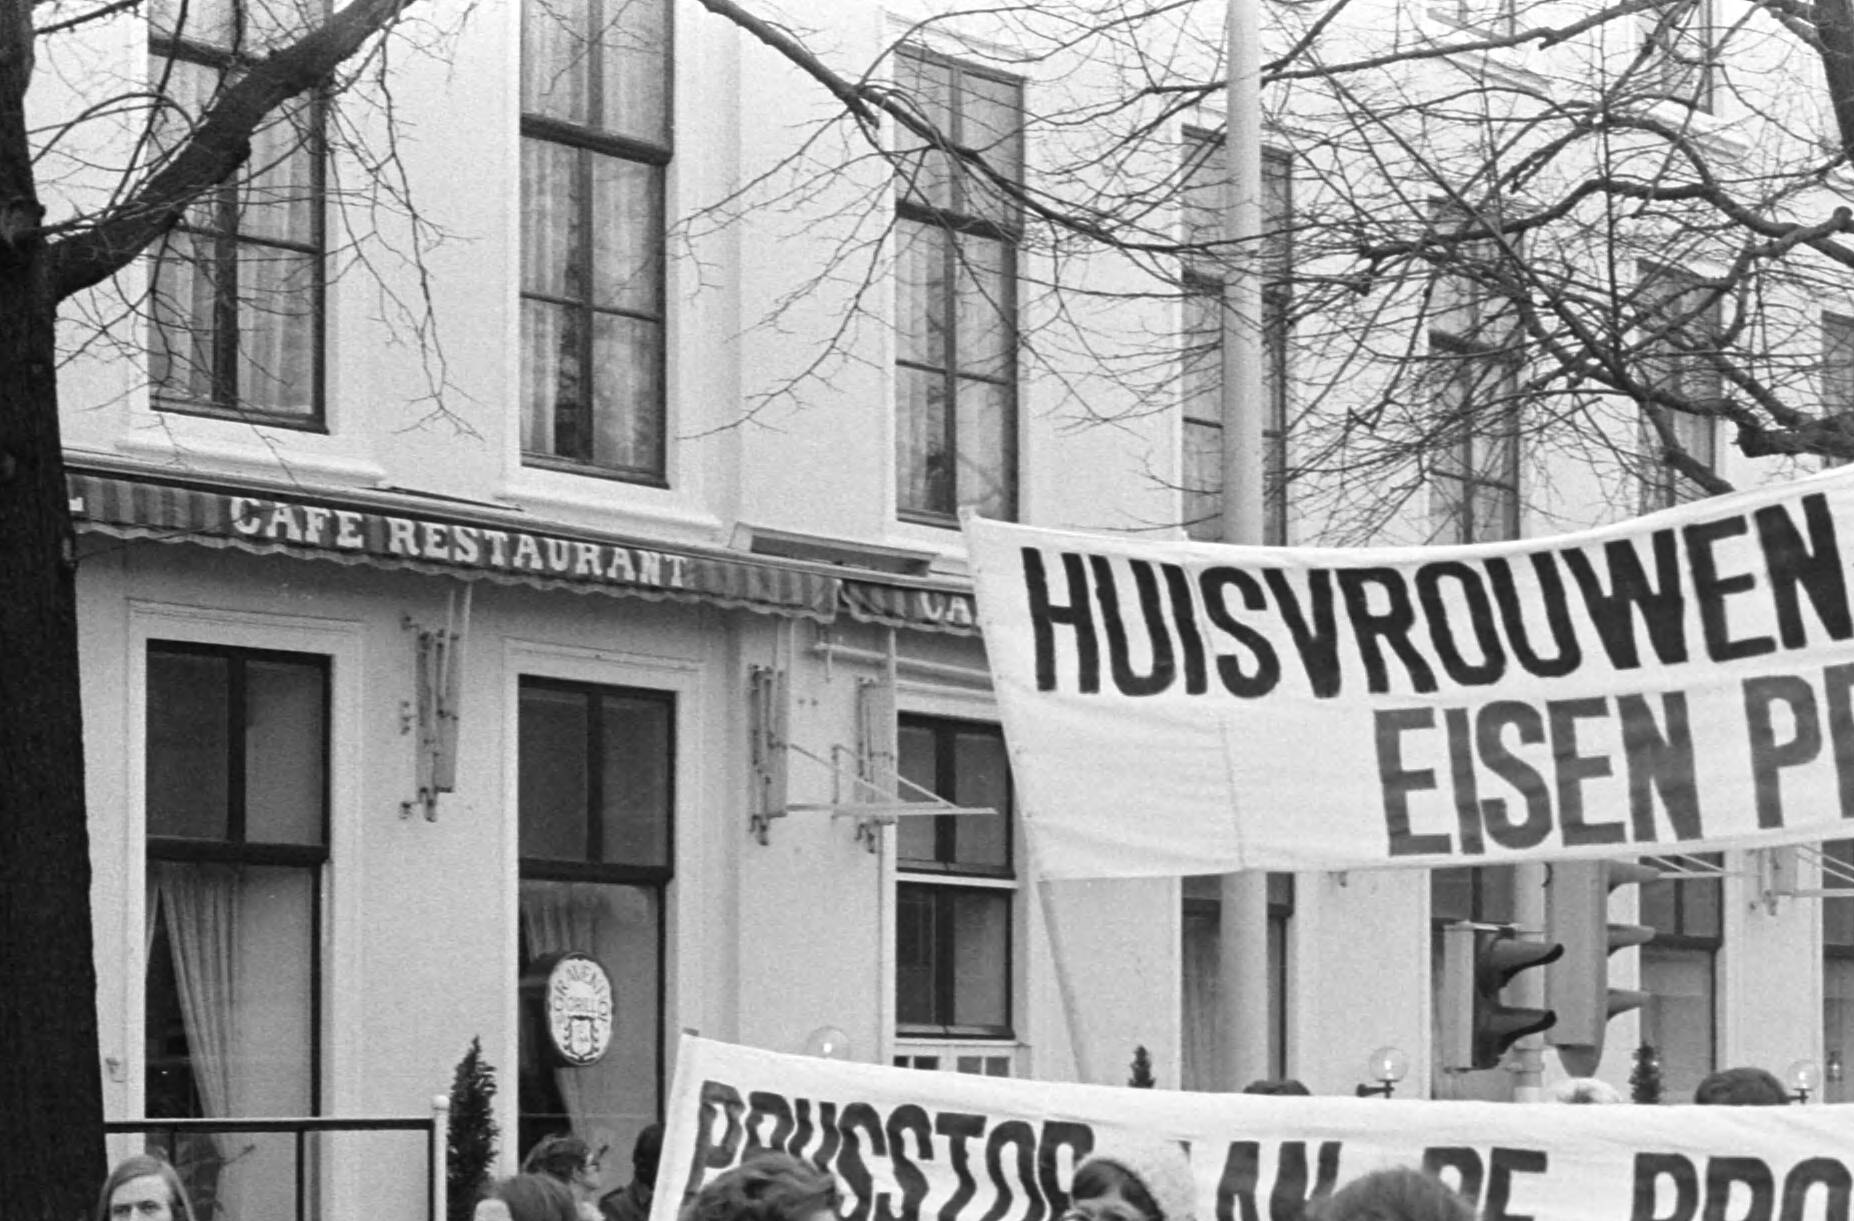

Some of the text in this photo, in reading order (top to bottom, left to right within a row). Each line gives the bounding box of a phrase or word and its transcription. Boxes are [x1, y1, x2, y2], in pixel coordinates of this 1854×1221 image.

[231, 496, 689, 588] CAFE RESTAURANT
[1021, 492, 1854, 699] HUISVROUWEN
[1375, 692, 1703, 856] EISEN
